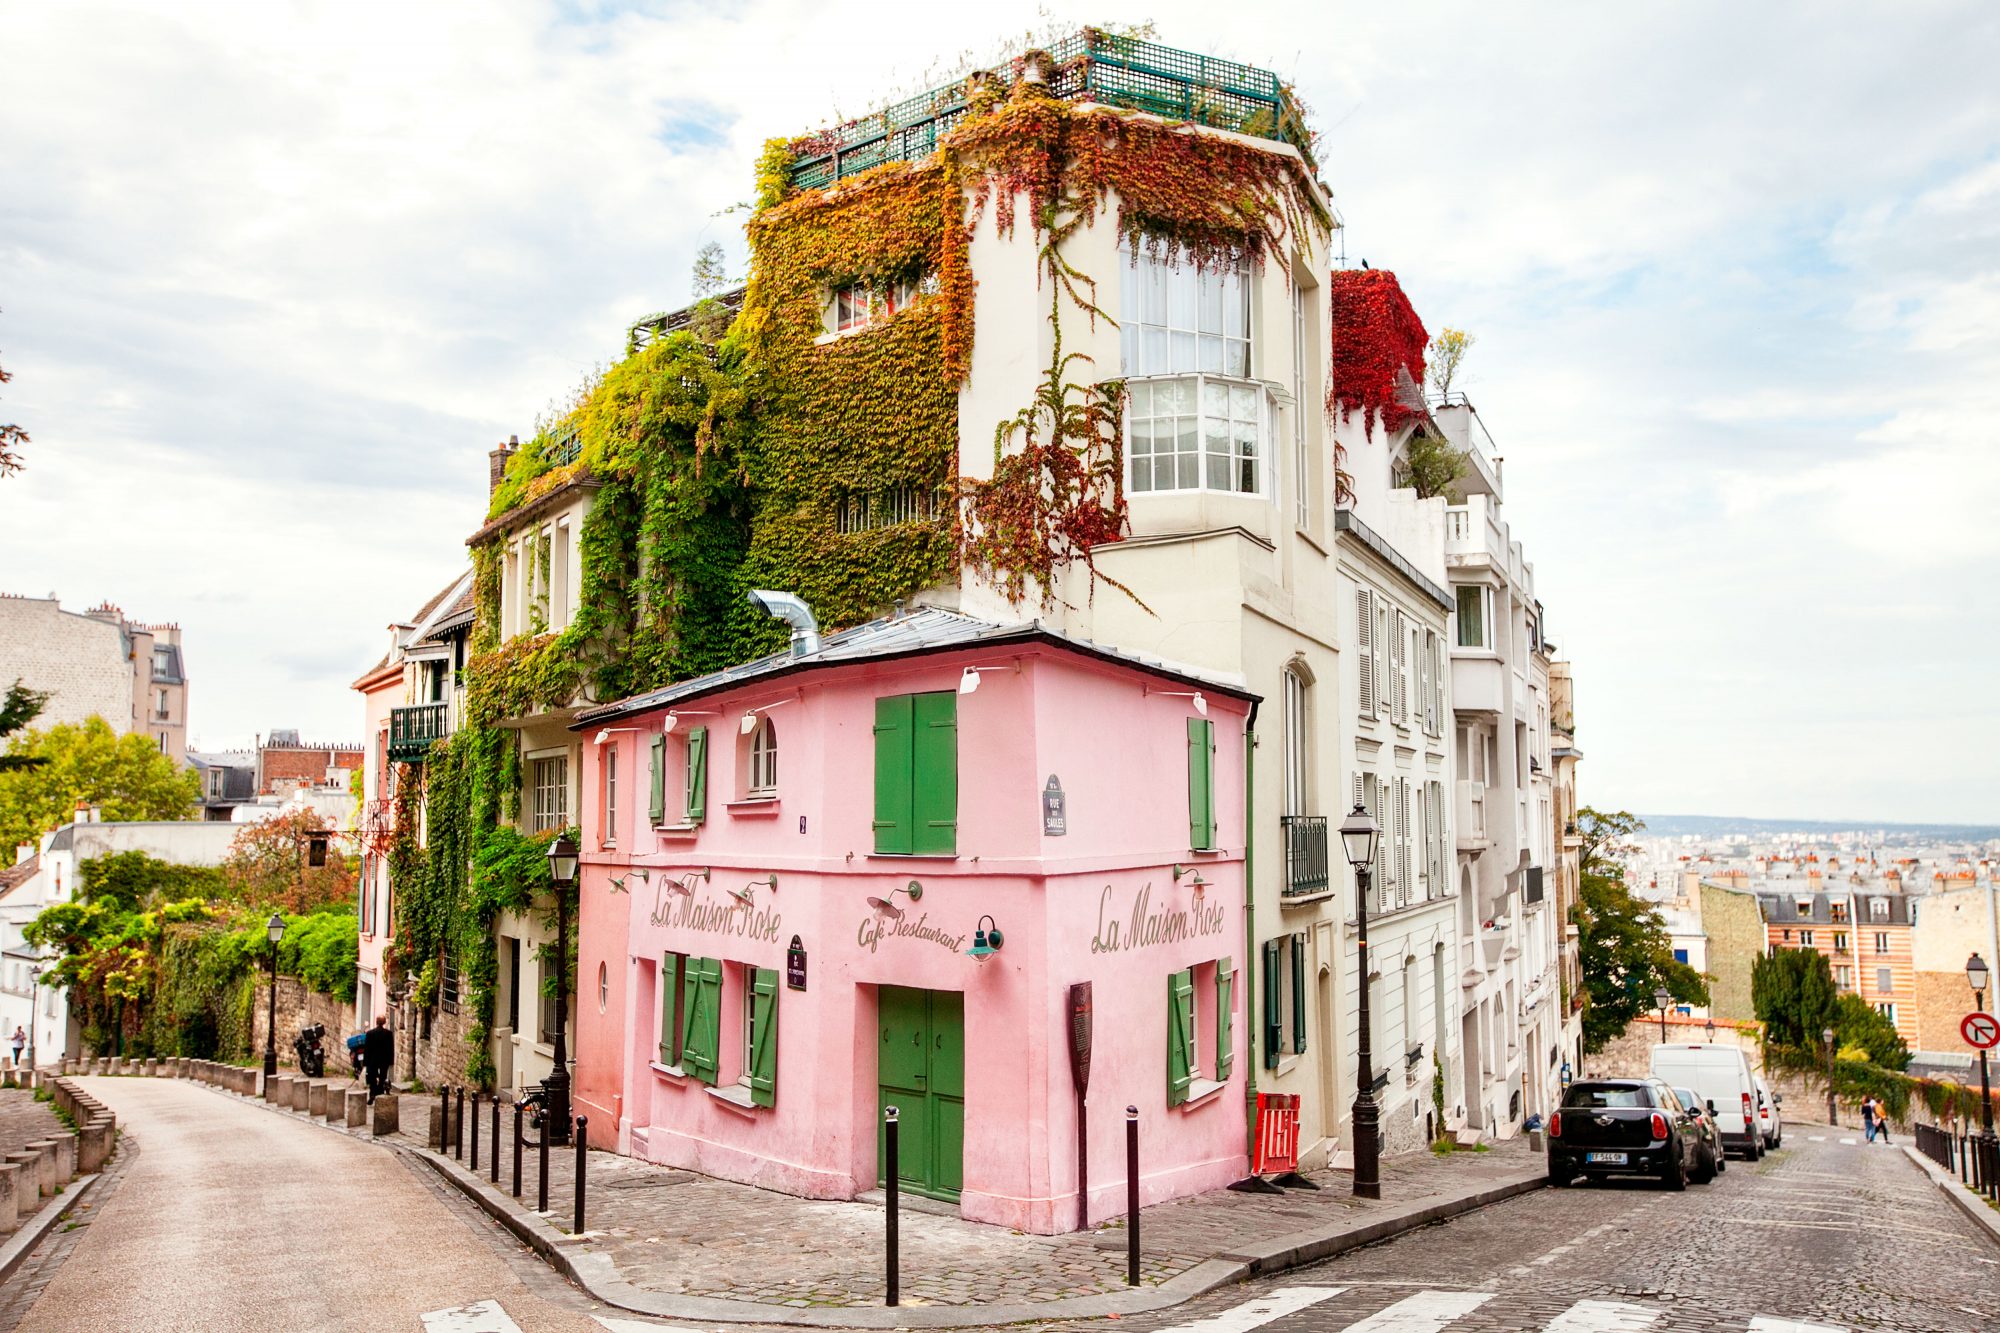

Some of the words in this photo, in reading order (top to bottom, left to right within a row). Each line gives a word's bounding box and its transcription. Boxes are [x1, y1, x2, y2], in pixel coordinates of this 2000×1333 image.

[1046, 817, 1064, 828] SAULES
[1049, 798, 1060, 809] RUE
[650, 874, 672, 928] La
[674, 875, 734, 935] Maison
[736, 888, 781, 945] Rose
[858, 918, 886, 954] Café
[887, 908, 966, 953] Restaurant
[1091, 885, 1120, 954] La
[1123, 882, 1188, 951] Maison
[1190, 889, 1225, 938] Rose
